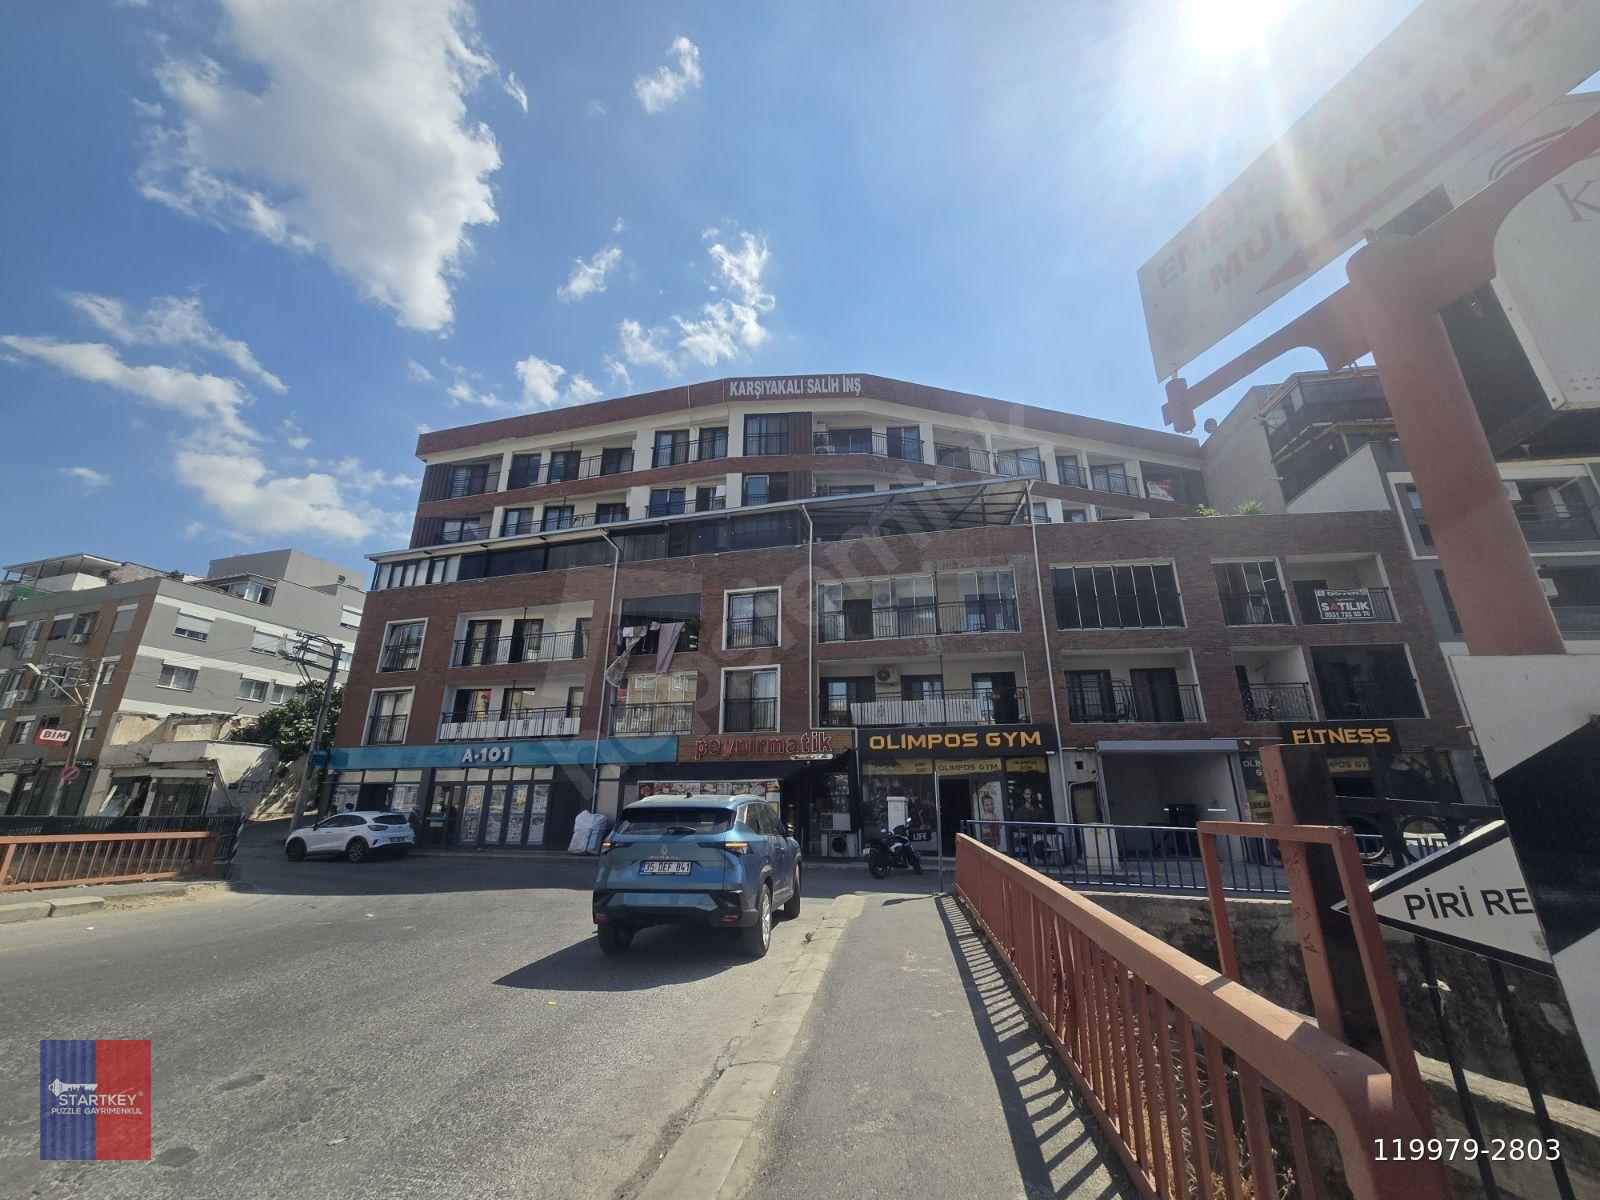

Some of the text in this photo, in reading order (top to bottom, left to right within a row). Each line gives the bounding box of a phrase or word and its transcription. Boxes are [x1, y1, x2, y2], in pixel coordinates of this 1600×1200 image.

[729, 374, 862, 399] KARŞIYAKALI SALİH İNŞ
[1321, 601, 1370, 611] SATILIK
[985, 731, 1042, 748] GYM
[1291, 727, 1392, 744] FITNESS
[694, 731, 833, 760] peynirmatik
[937, 764, 976, 773] OLIMPOS
[979, 763, 999, 771] GYM
[912, 832, 928, 841] LIFE
[645, 862, 690, 872] 35 DEF 841
[1403, 884, 1475, 920] PİRİ
